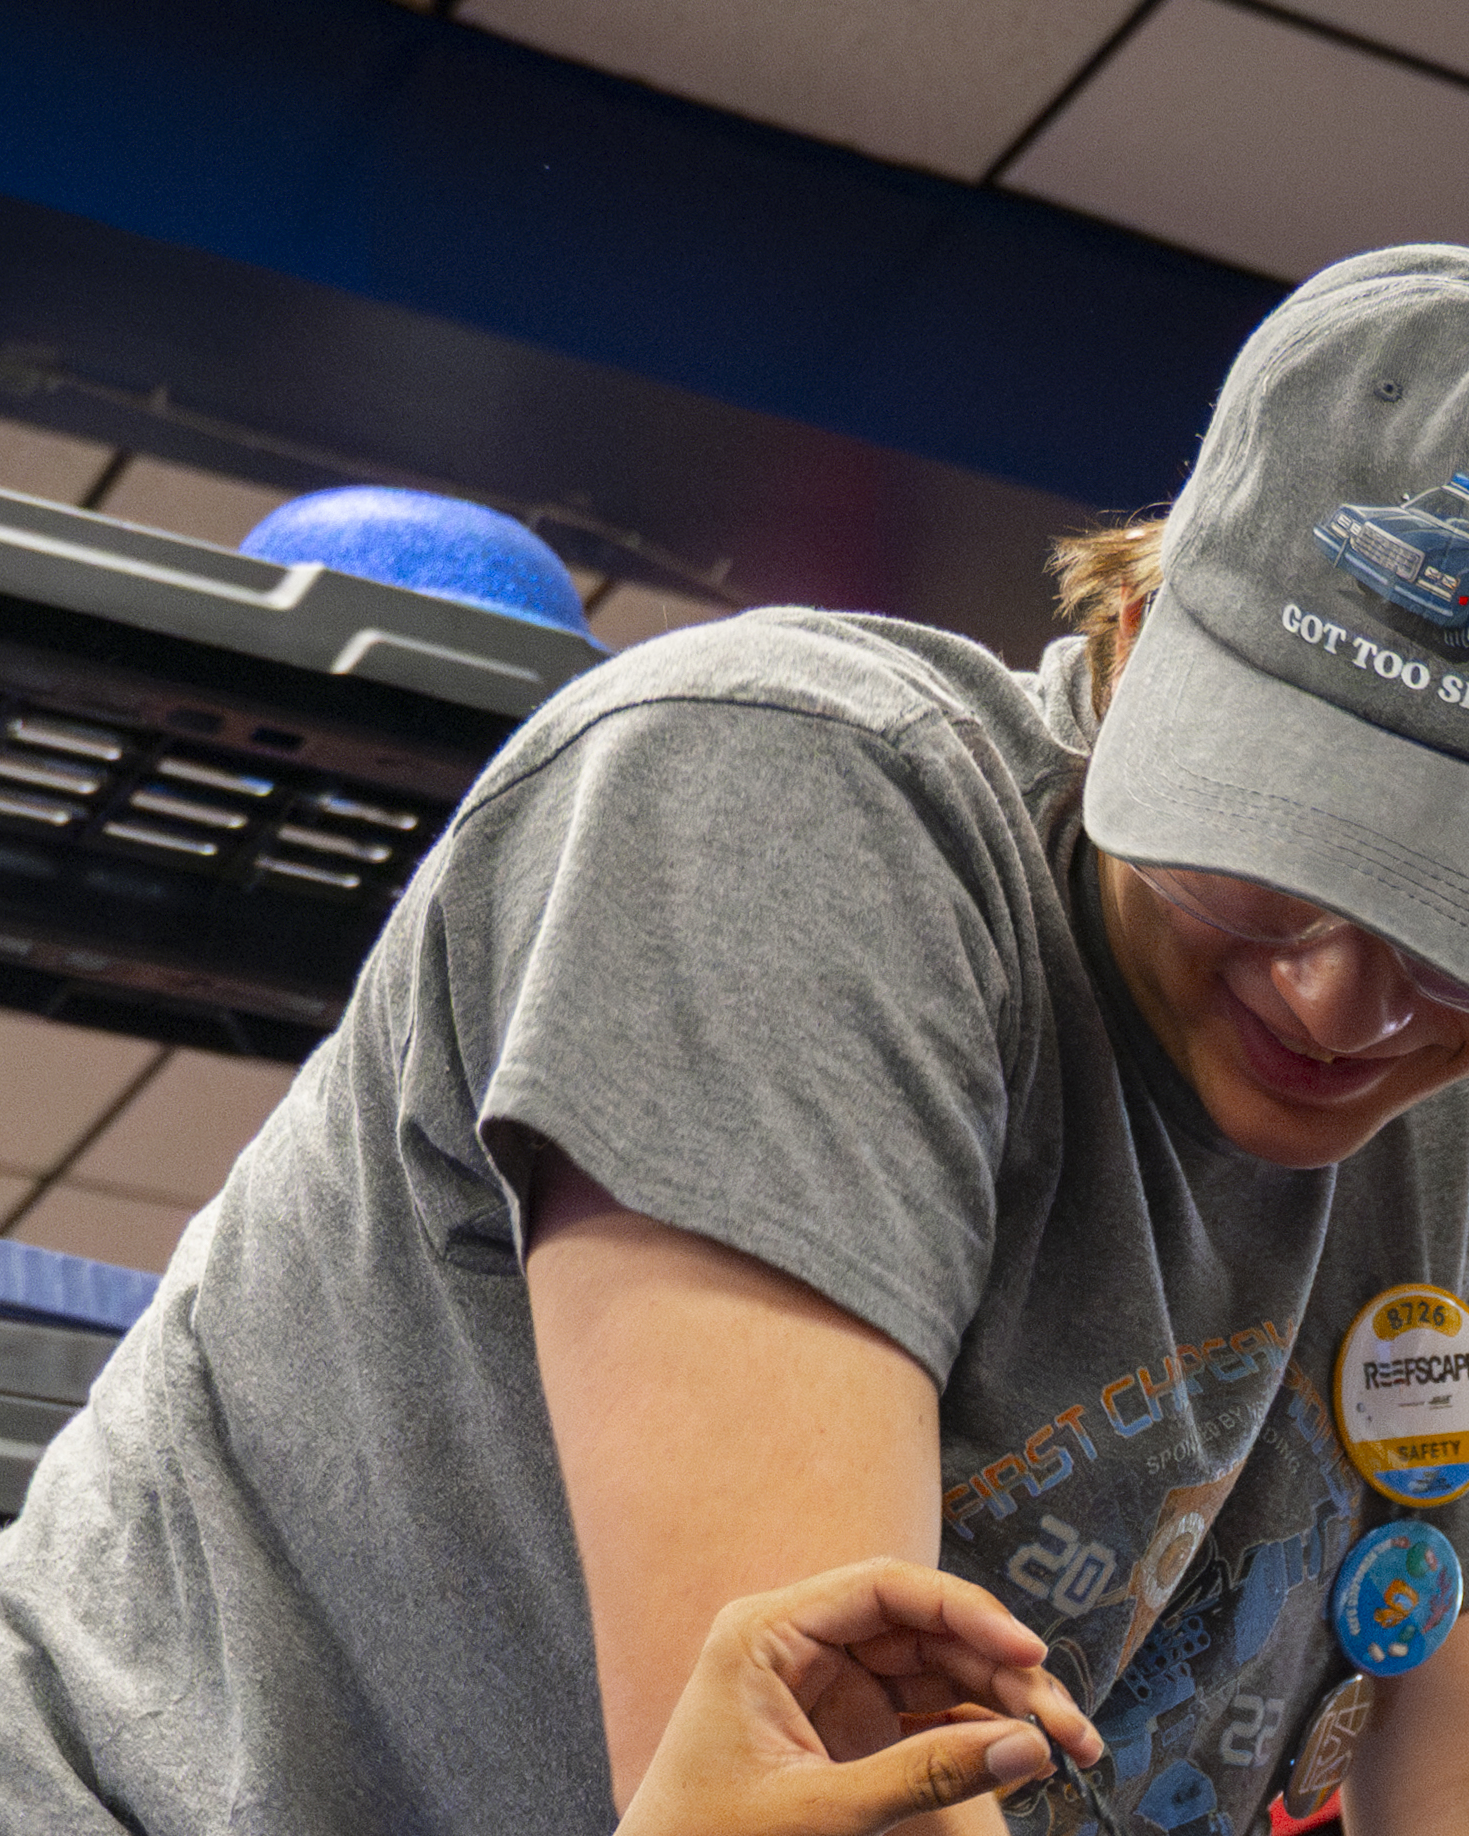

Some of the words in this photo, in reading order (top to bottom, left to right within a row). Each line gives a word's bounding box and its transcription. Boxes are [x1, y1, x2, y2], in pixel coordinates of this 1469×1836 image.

[1282, 603, 1346, 655] GOT
[1351, 636, 1431, 690] TOO
[1386, 1300, 1446, 1330] 8726
[941, 1403, 1098, 1542] FIRST
[1397, 1439, 1462, 1462] SAFETY
[1006, 1514, 1118, 1619] 20
